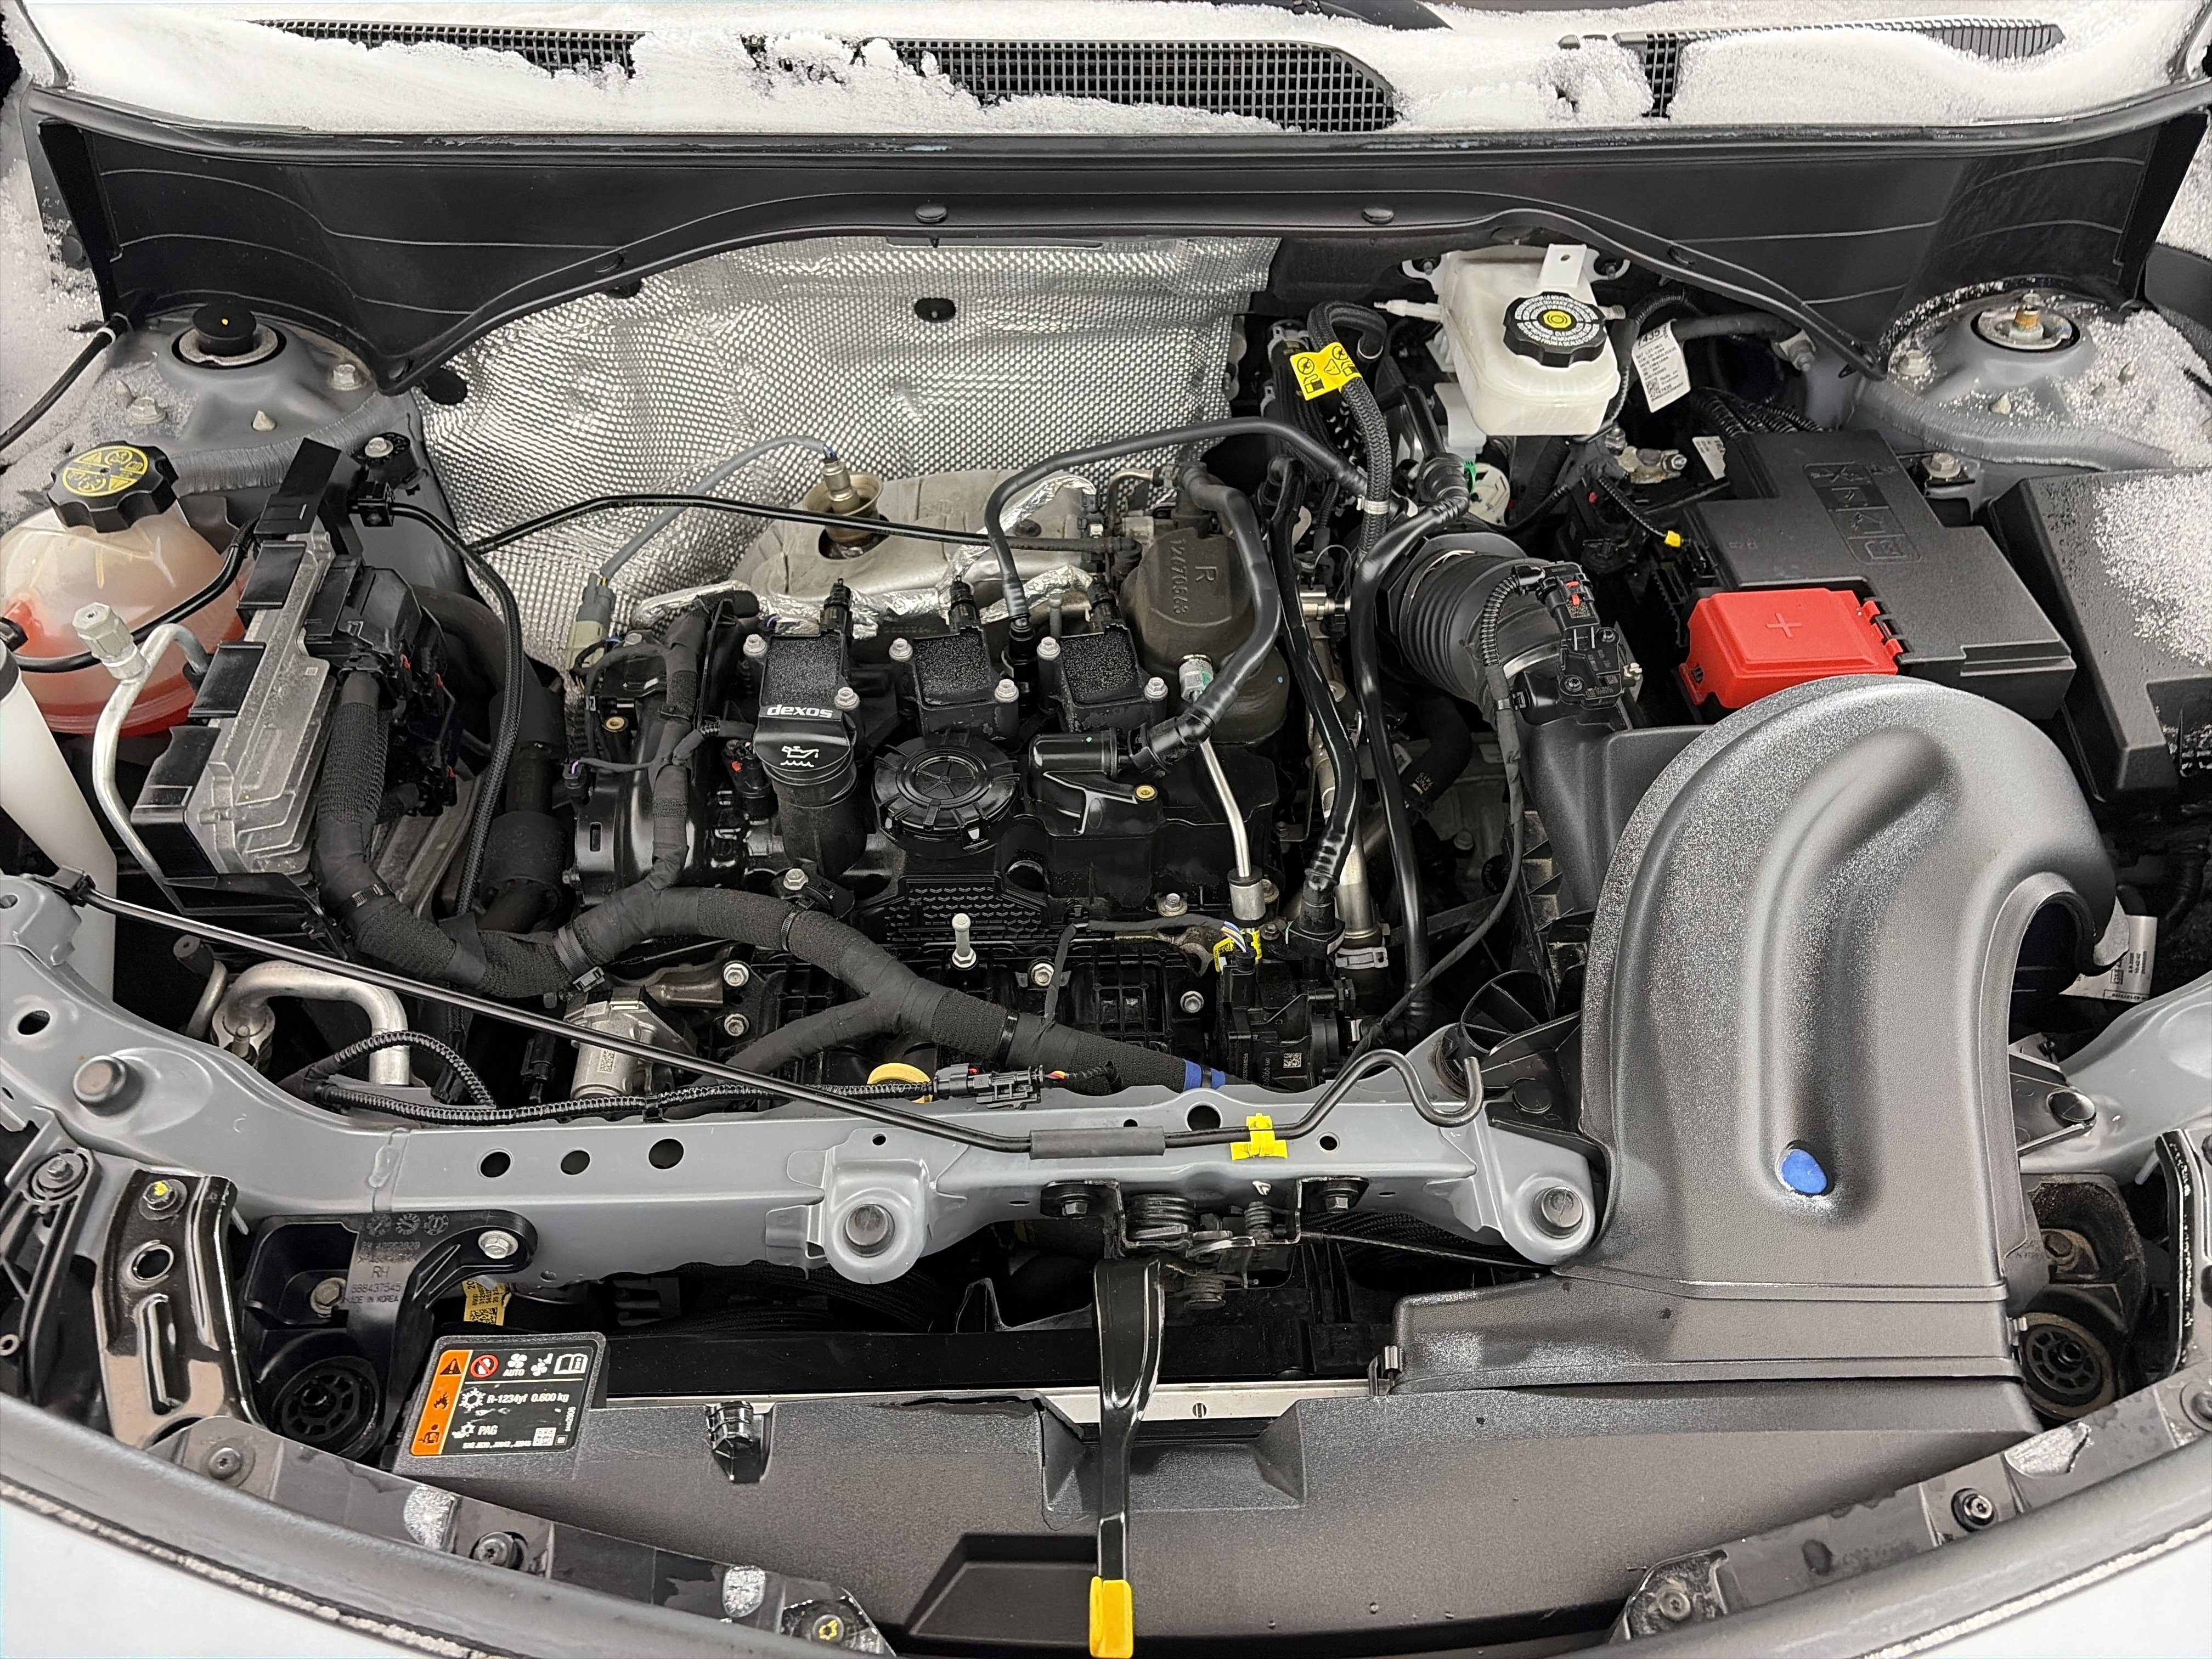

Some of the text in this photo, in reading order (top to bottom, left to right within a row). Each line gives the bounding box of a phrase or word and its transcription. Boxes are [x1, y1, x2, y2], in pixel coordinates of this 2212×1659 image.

[1195, 567, 1217, 582] R
[767, 704, 833, 718] dexos
[372, 1266, 390, 1278] RH
[377, 1295, 399, 1303] KOREA
[487, 1392, 569, 1404] R-1234yf 0.600 kg
[478, 1425, 498, 1435] PAG
